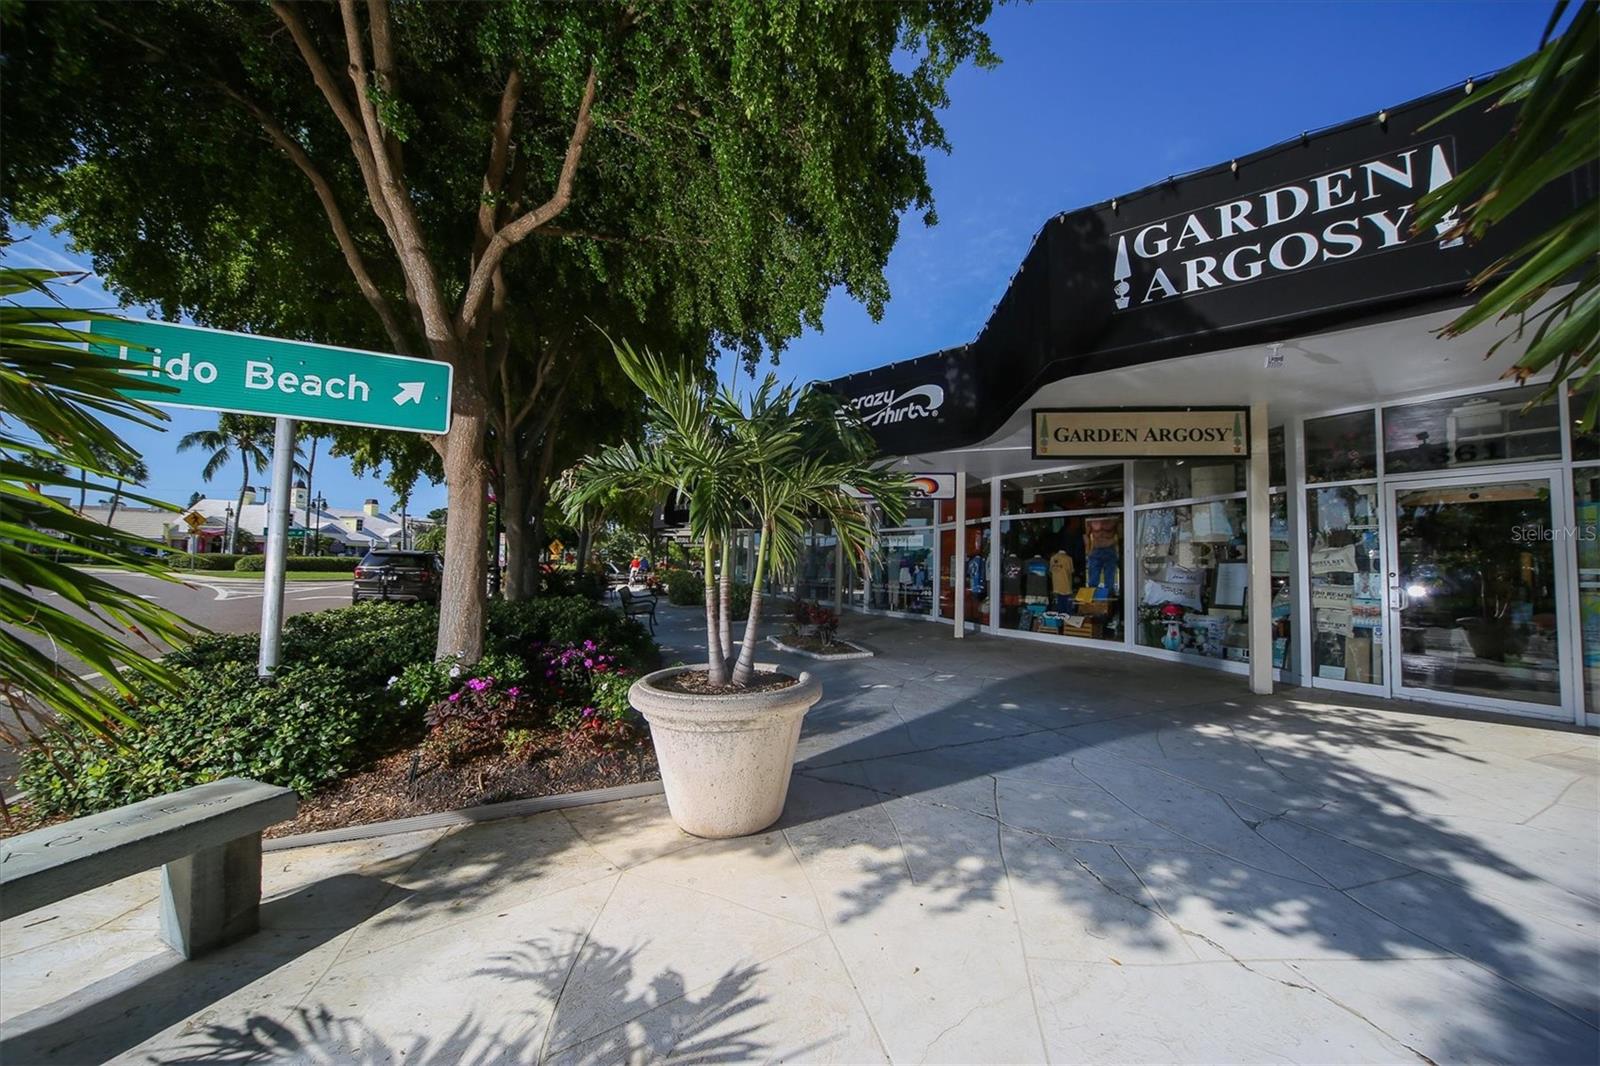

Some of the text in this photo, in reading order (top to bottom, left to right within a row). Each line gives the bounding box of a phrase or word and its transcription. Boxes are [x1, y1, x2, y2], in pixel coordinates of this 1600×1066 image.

[1134, 149, 1418, 259] GARDEN
[1141, 204, 1415, 304] ARGOSY
[118, 345, 370, 402] Lido Beach
[1053, 426, 1230, 444] GARDEN ARGOSY
